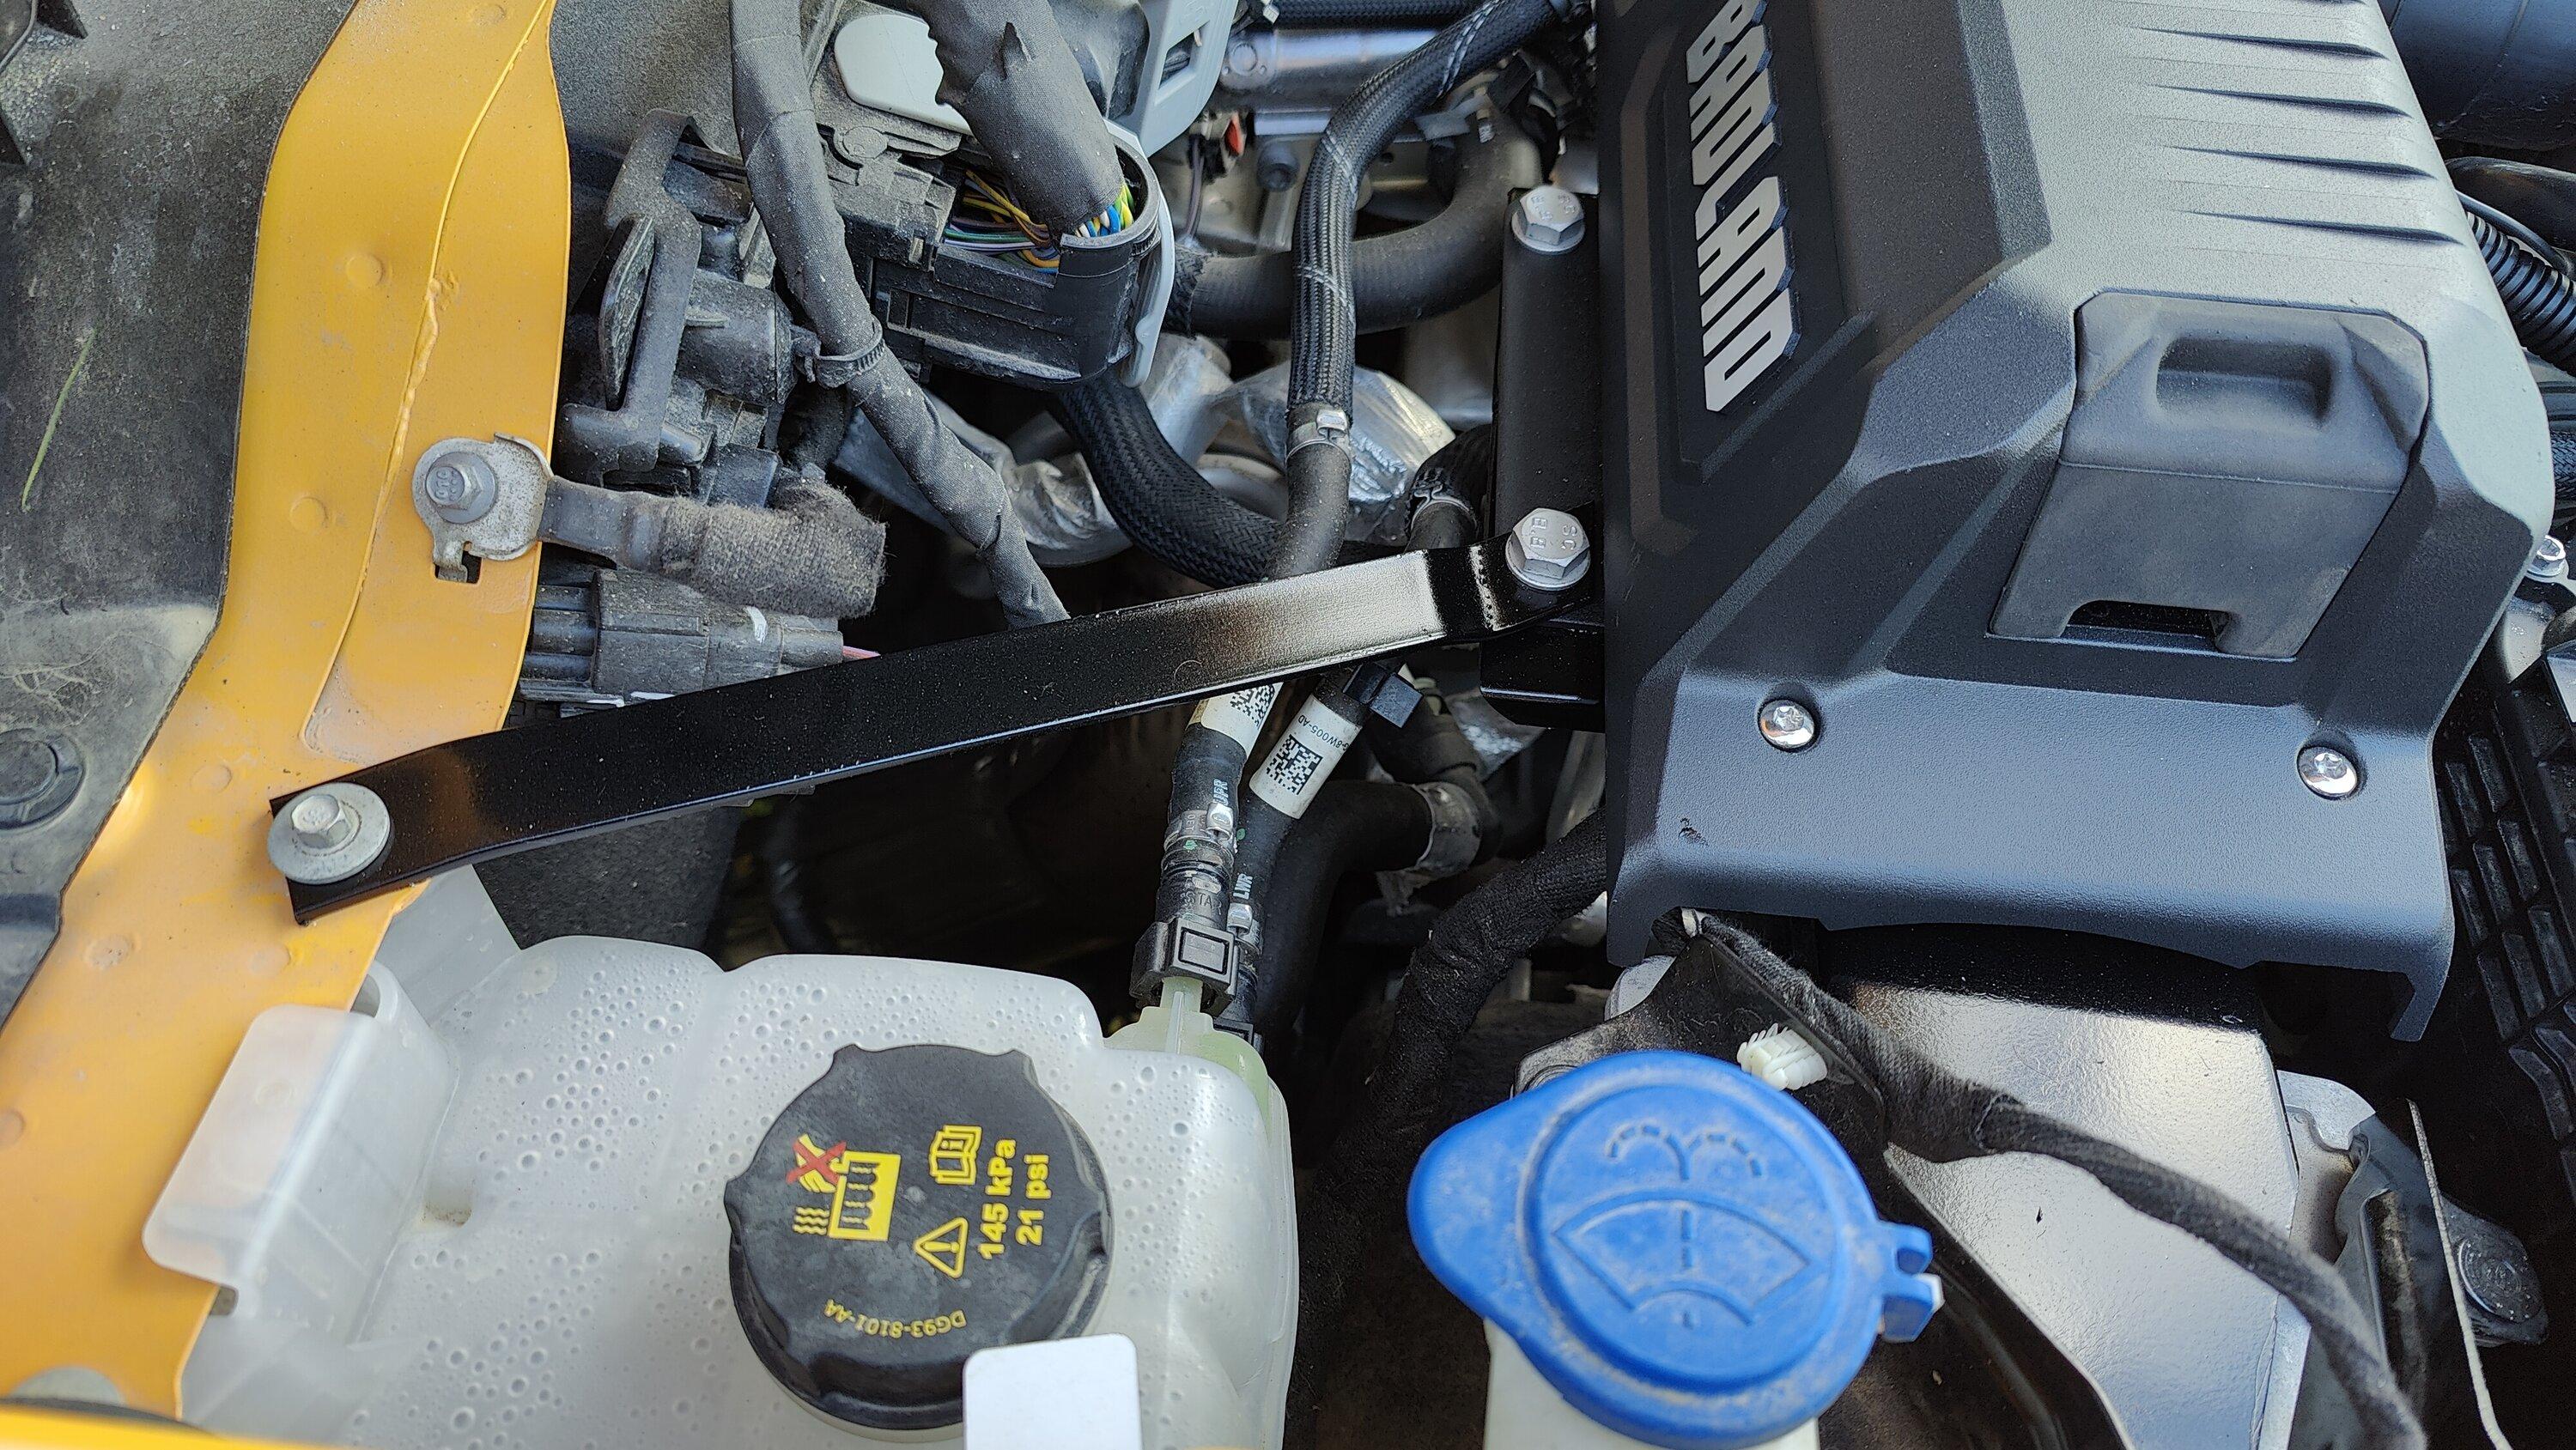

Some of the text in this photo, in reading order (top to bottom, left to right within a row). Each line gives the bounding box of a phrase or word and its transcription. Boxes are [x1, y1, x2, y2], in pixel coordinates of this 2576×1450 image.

[1686, 0, 1795, 412] BADLAND
[1232, 873, 1254, 901] LWR
[978, 1138, 1017, 1260] 145 kPa
[1015, 1154, 1053, 1246] 21 psi
[823, 1299, 968, 1338] DG93-8101-AA
